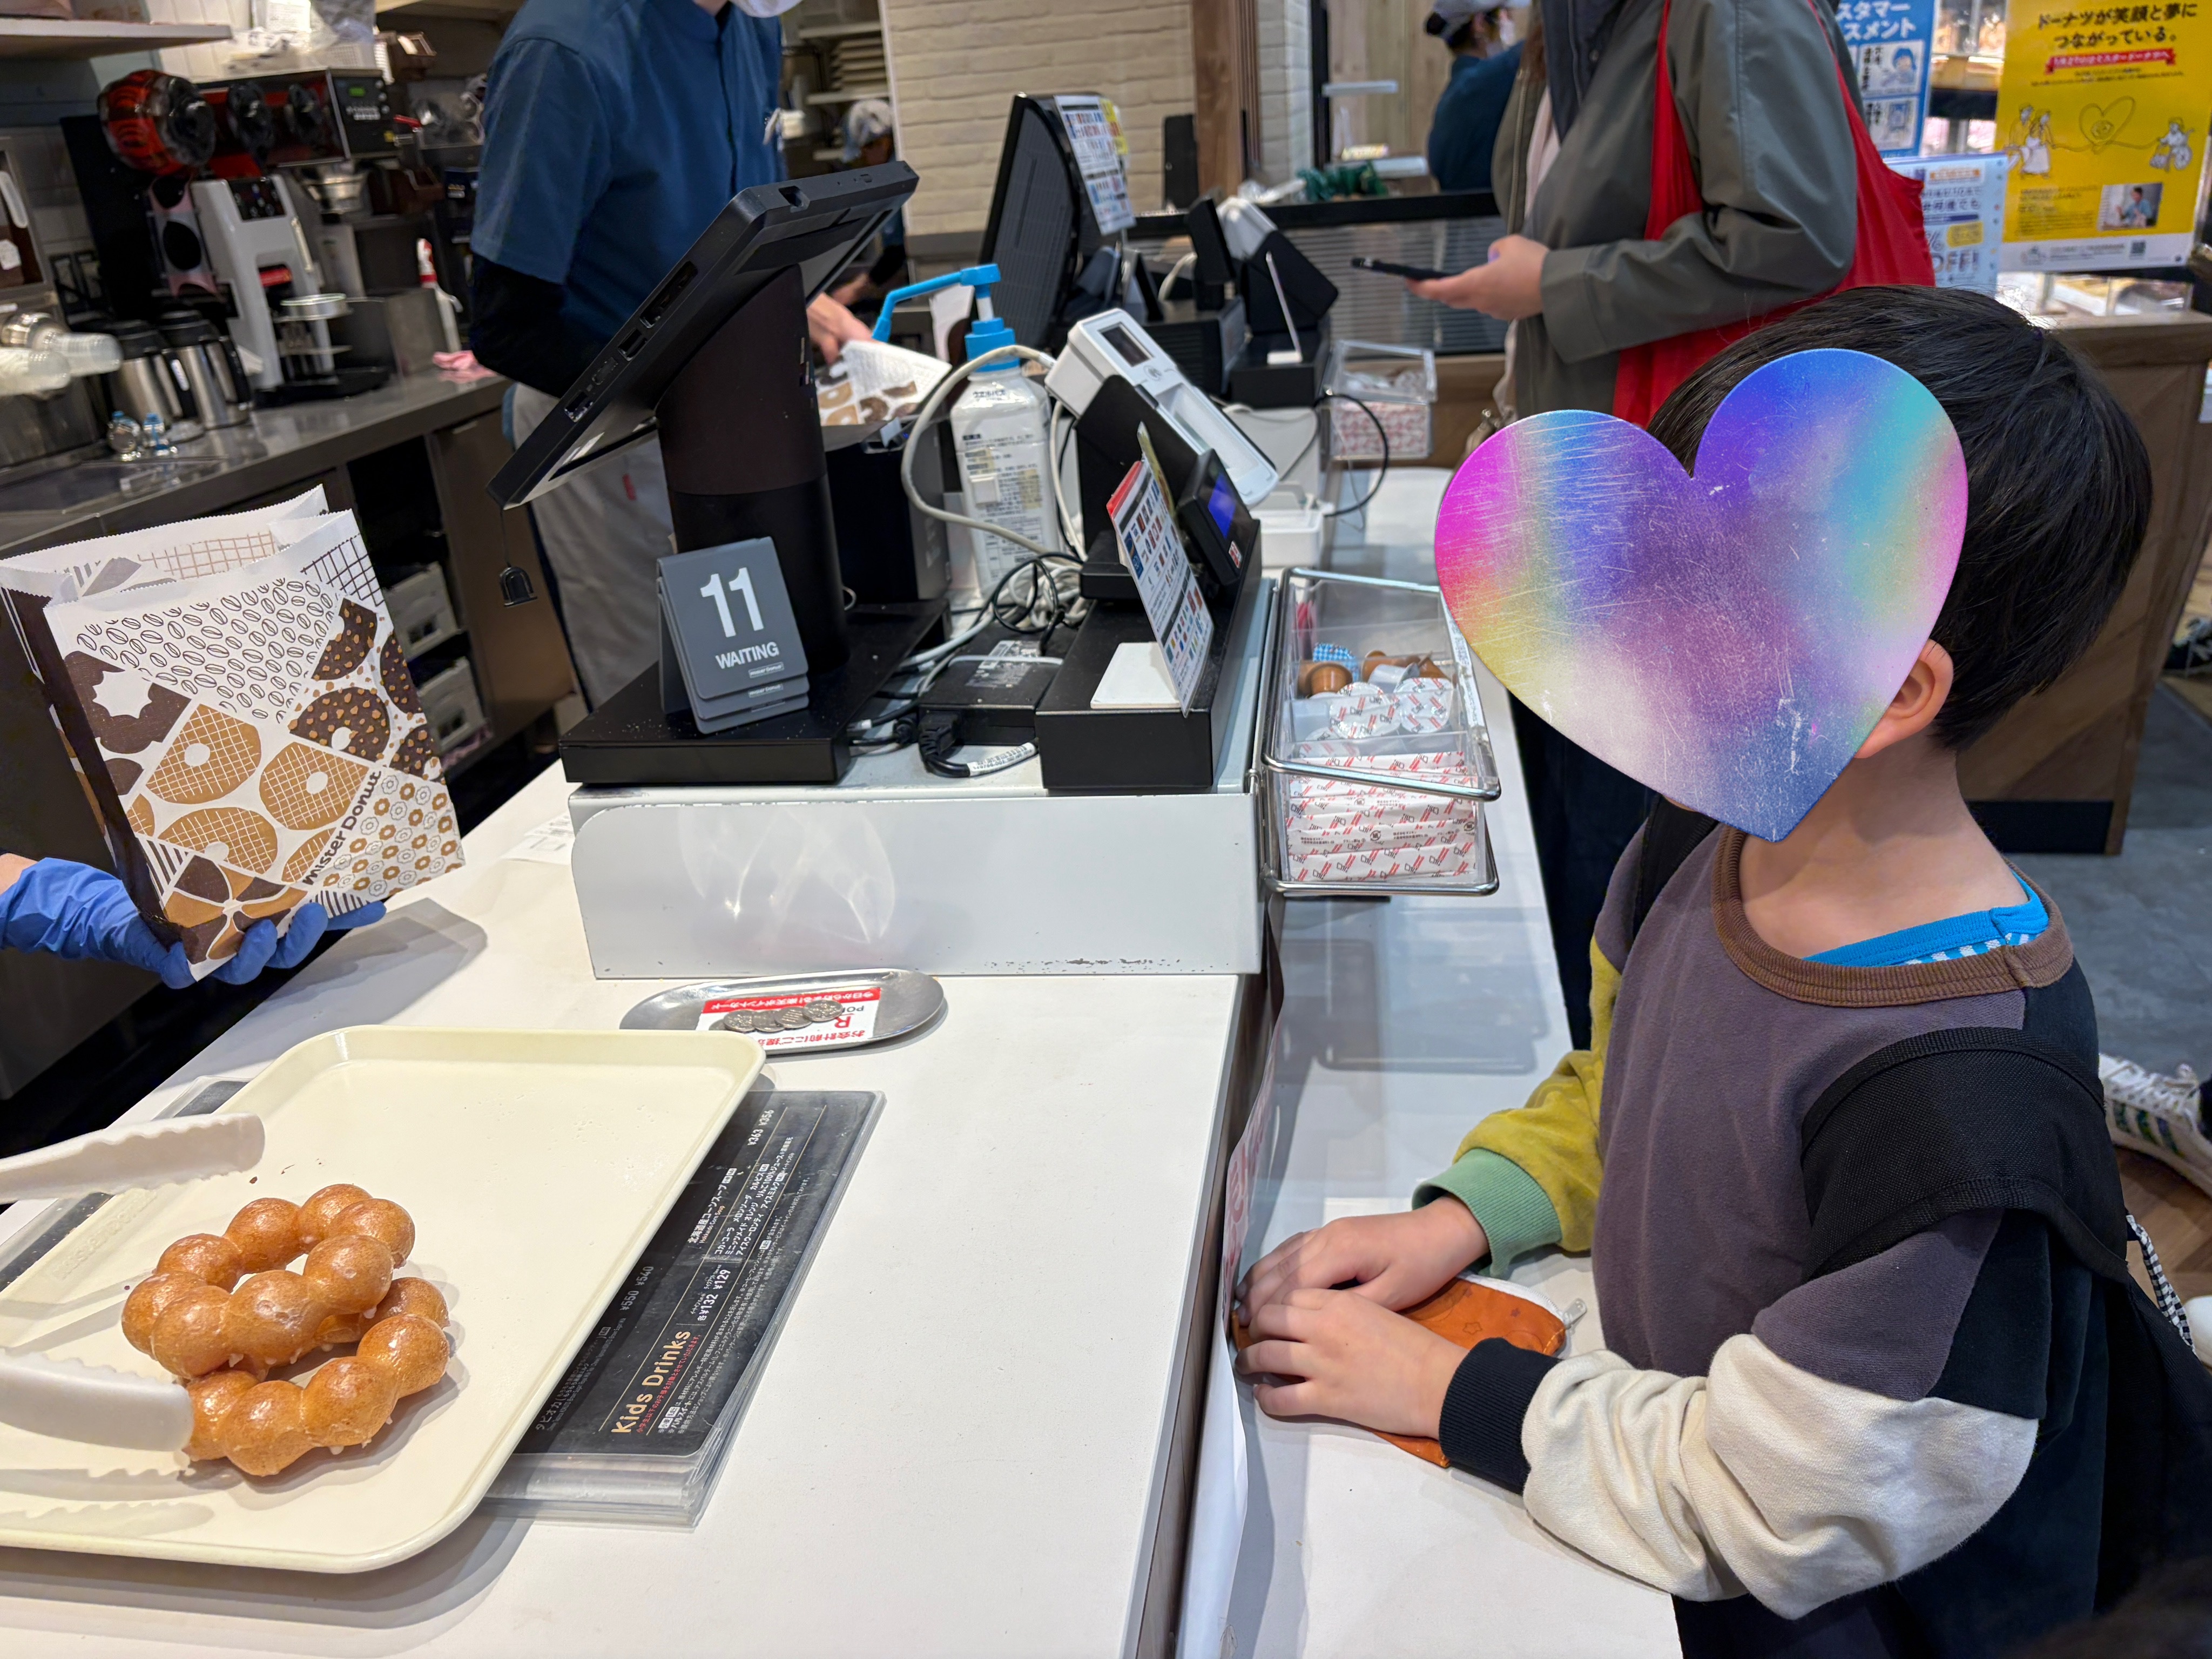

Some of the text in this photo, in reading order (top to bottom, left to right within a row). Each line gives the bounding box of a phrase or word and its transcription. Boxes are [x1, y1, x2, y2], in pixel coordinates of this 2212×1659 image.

[2038, 3, 2198, 30] ドーナツが笑顔と夢に
[2054, 25, 2176, 49] つながっている。
[700, 567, 764, 637] 11
[716, 642, 779, 670] WAITING
[341, 771, 382, 831] Donut
[834, 1015, 852, 1028] R
[841, 1005, 865, 1013] POI
[687, 1184, 727, 1243] 北海道産コーンスープ
[747, 1129, 764, 1145] ¥363
[758, 1109, 774, 1125] ¥356
[709, 1215, 719, 1225] Corn
[714, 1205, 725, 1215] Soup
[714, 1226, 734, 1255] コカ・コーラ
[733, 1194, 752, 1222] メロンソーダ
[749, 1172, 766, 1190] カルピス
[724, 1222, 748, 1255] ミニッツメイド
[744, 1202, 758, 1220] オレンジ
[735, 1213, 764, 1255] アイスウーロンティ
[760, 1181, 780, 1209] アイスミルク
[619, 1290, 639, 1310] ¥550
[635, 1266, 654, 1285] ¥540
[697, 1269, 731, 1321] 各¥132 ¥129
[610, 1331, 691, 1433] Kids Drinks
